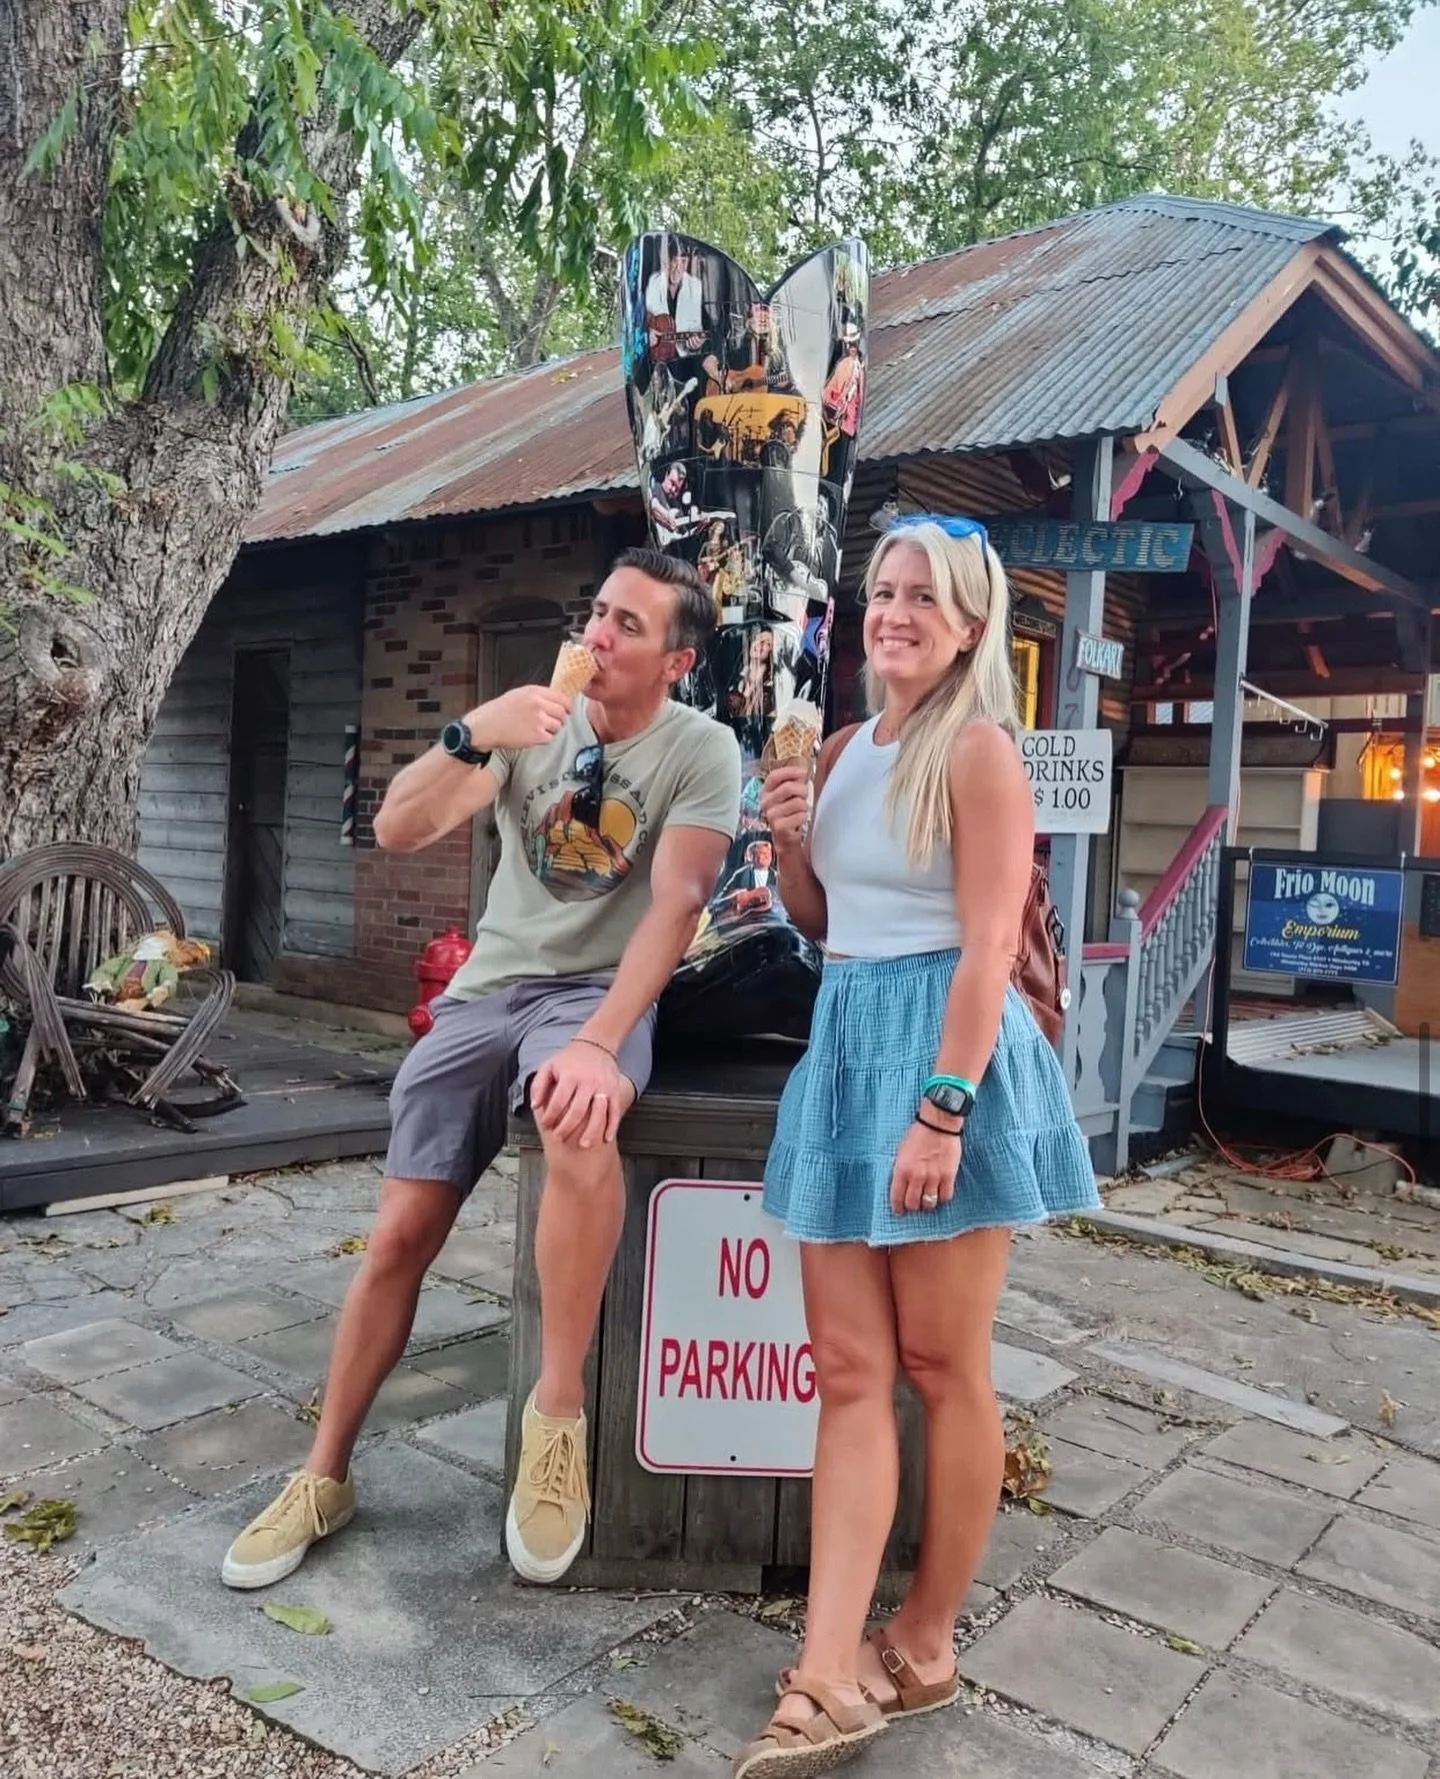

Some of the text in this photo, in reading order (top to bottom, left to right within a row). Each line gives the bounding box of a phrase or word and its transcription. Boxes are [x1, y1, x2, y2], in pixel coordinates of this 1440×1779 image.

[1022, 735, 1076, 758] COLD
[1023, 759, 1105, 783] DRINKS
[1033, 786, 1091, 810] $ 1.00
[1273, 868, 1376, 906] Frio Moon
[1281, 919, 1361, 941] Emporium
[718, 1237, 771, 1300] NO
[658, 1337, 818, 1404] PARKING
